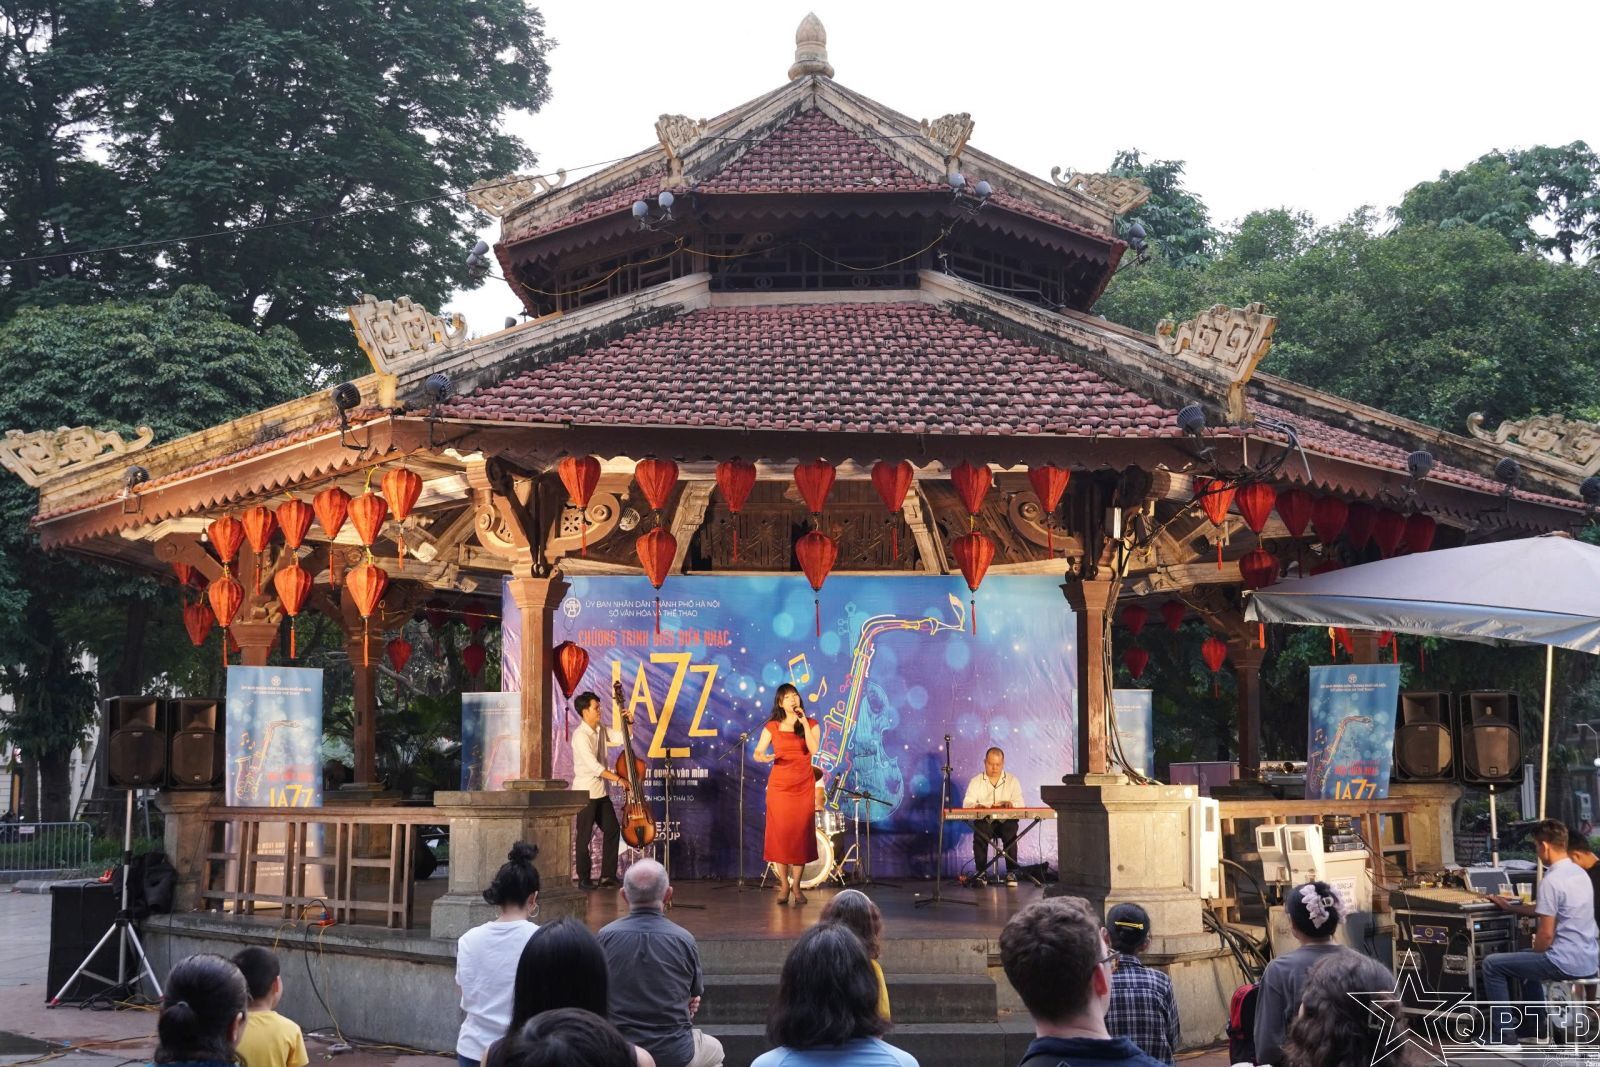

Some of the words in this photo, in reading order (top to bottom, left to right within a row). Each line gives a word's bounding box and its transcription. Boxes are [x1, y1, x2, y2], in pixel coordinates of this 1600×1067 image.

[596, 600, 611, 608] BAN
[612, 600, 634, 608] NHÂN
[635, 600, 651, 608] DÂN
[678, 599, 694, 608] PHỐ
[695, 600, 706, 608] HÀ
[707, 599, 721, 609] NỘI
[678, 609, 698, 617] THAO
[606, 652, 719, 759] JAZZ
[655, 821, 681, 832] EXT
